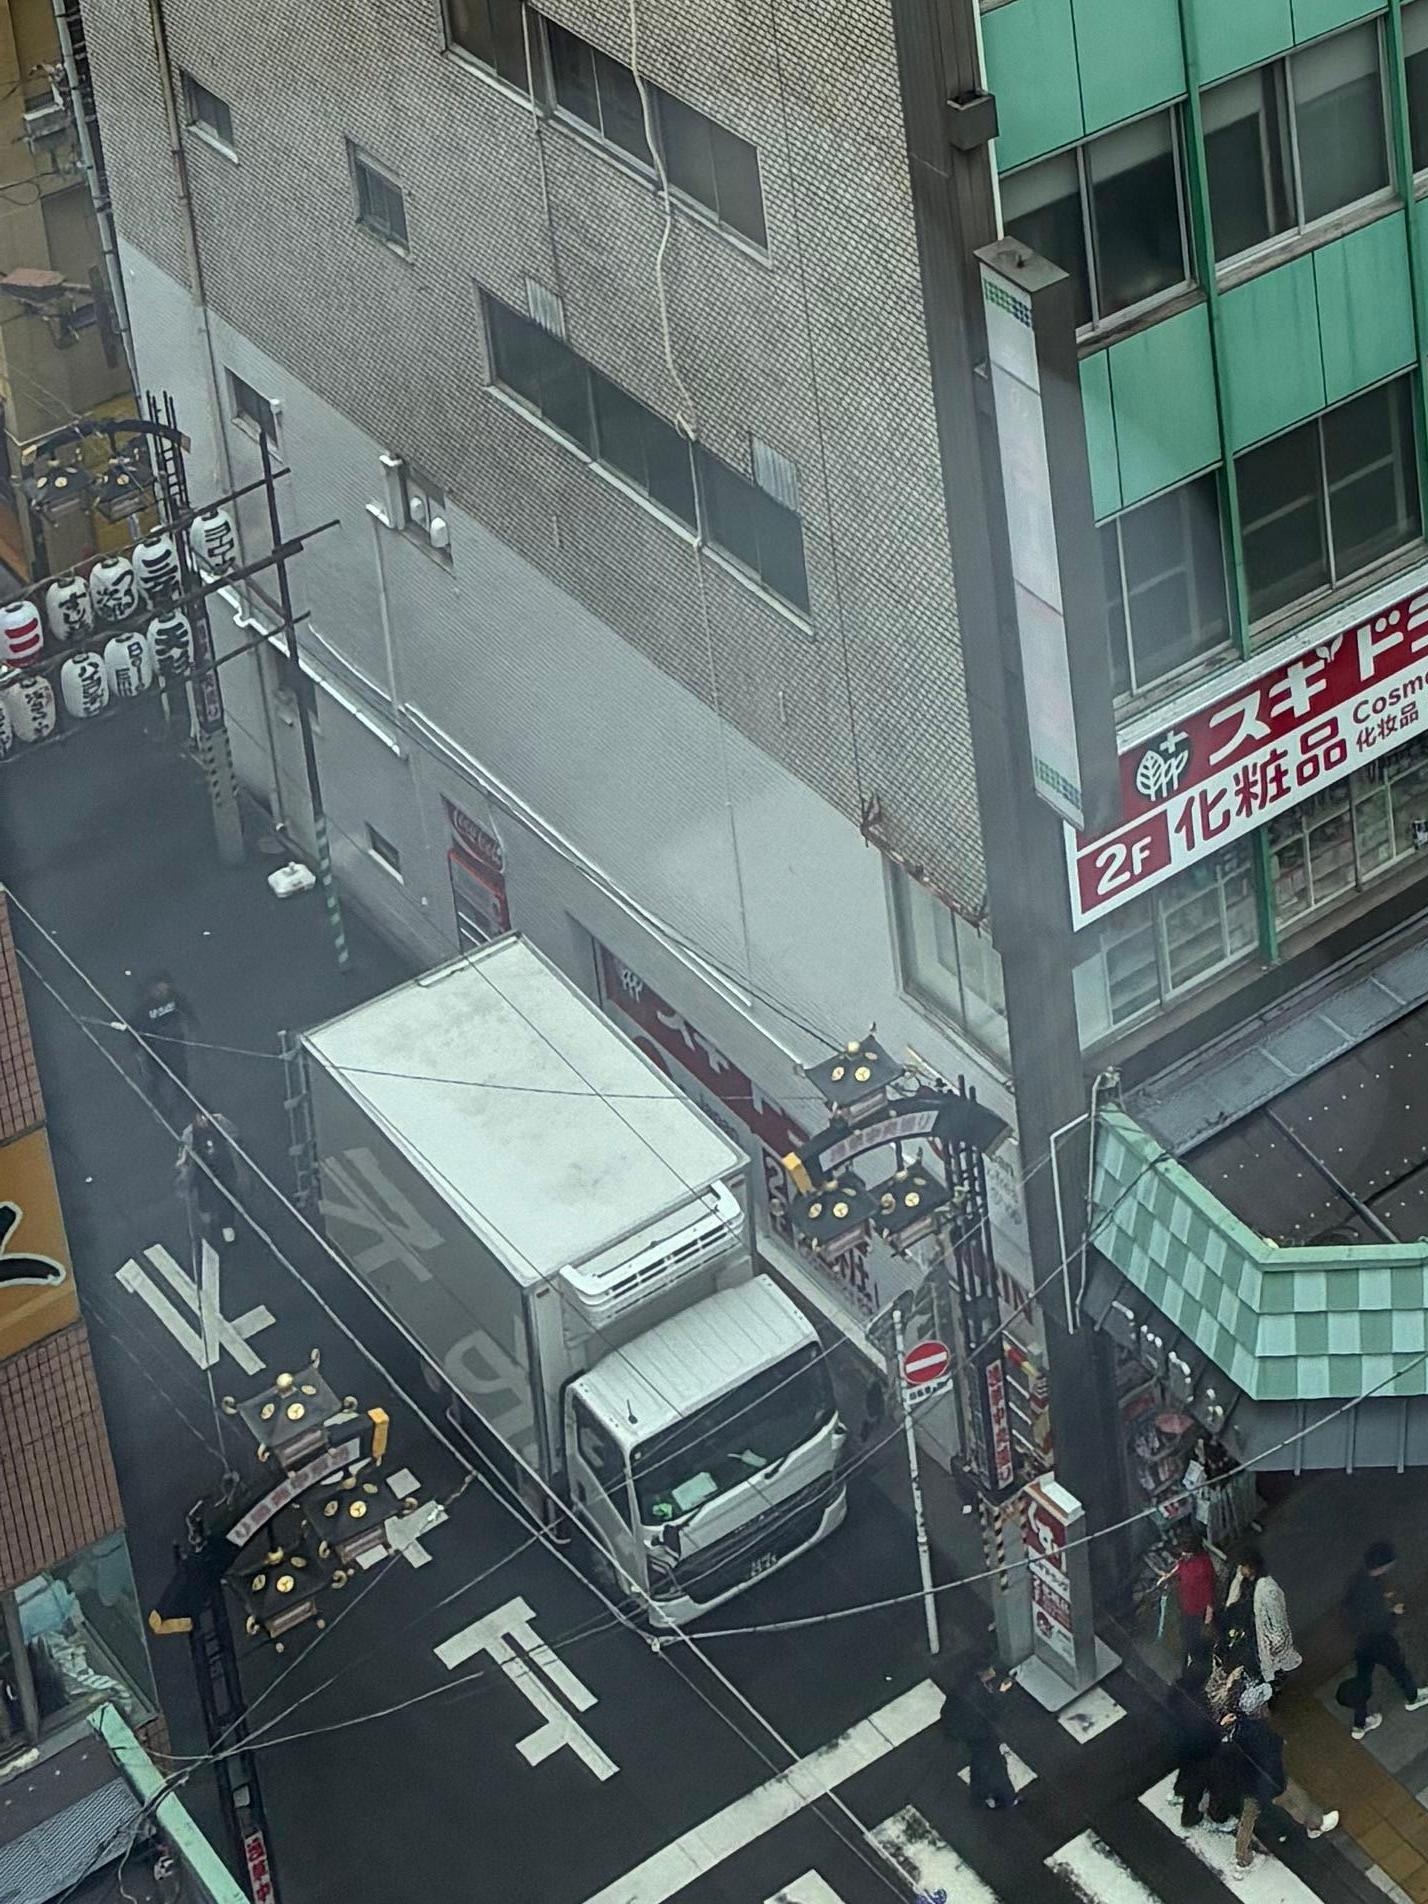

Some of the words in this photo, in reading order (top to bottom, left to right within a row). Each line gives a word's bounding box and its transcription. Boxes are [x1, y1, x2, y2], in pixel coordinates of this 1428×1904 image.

[1354, 698, 1421, 755] 化妆品
[1174, 715, 1349, 854] 化粧品
[1095, 838, 1152, 896] 2F
